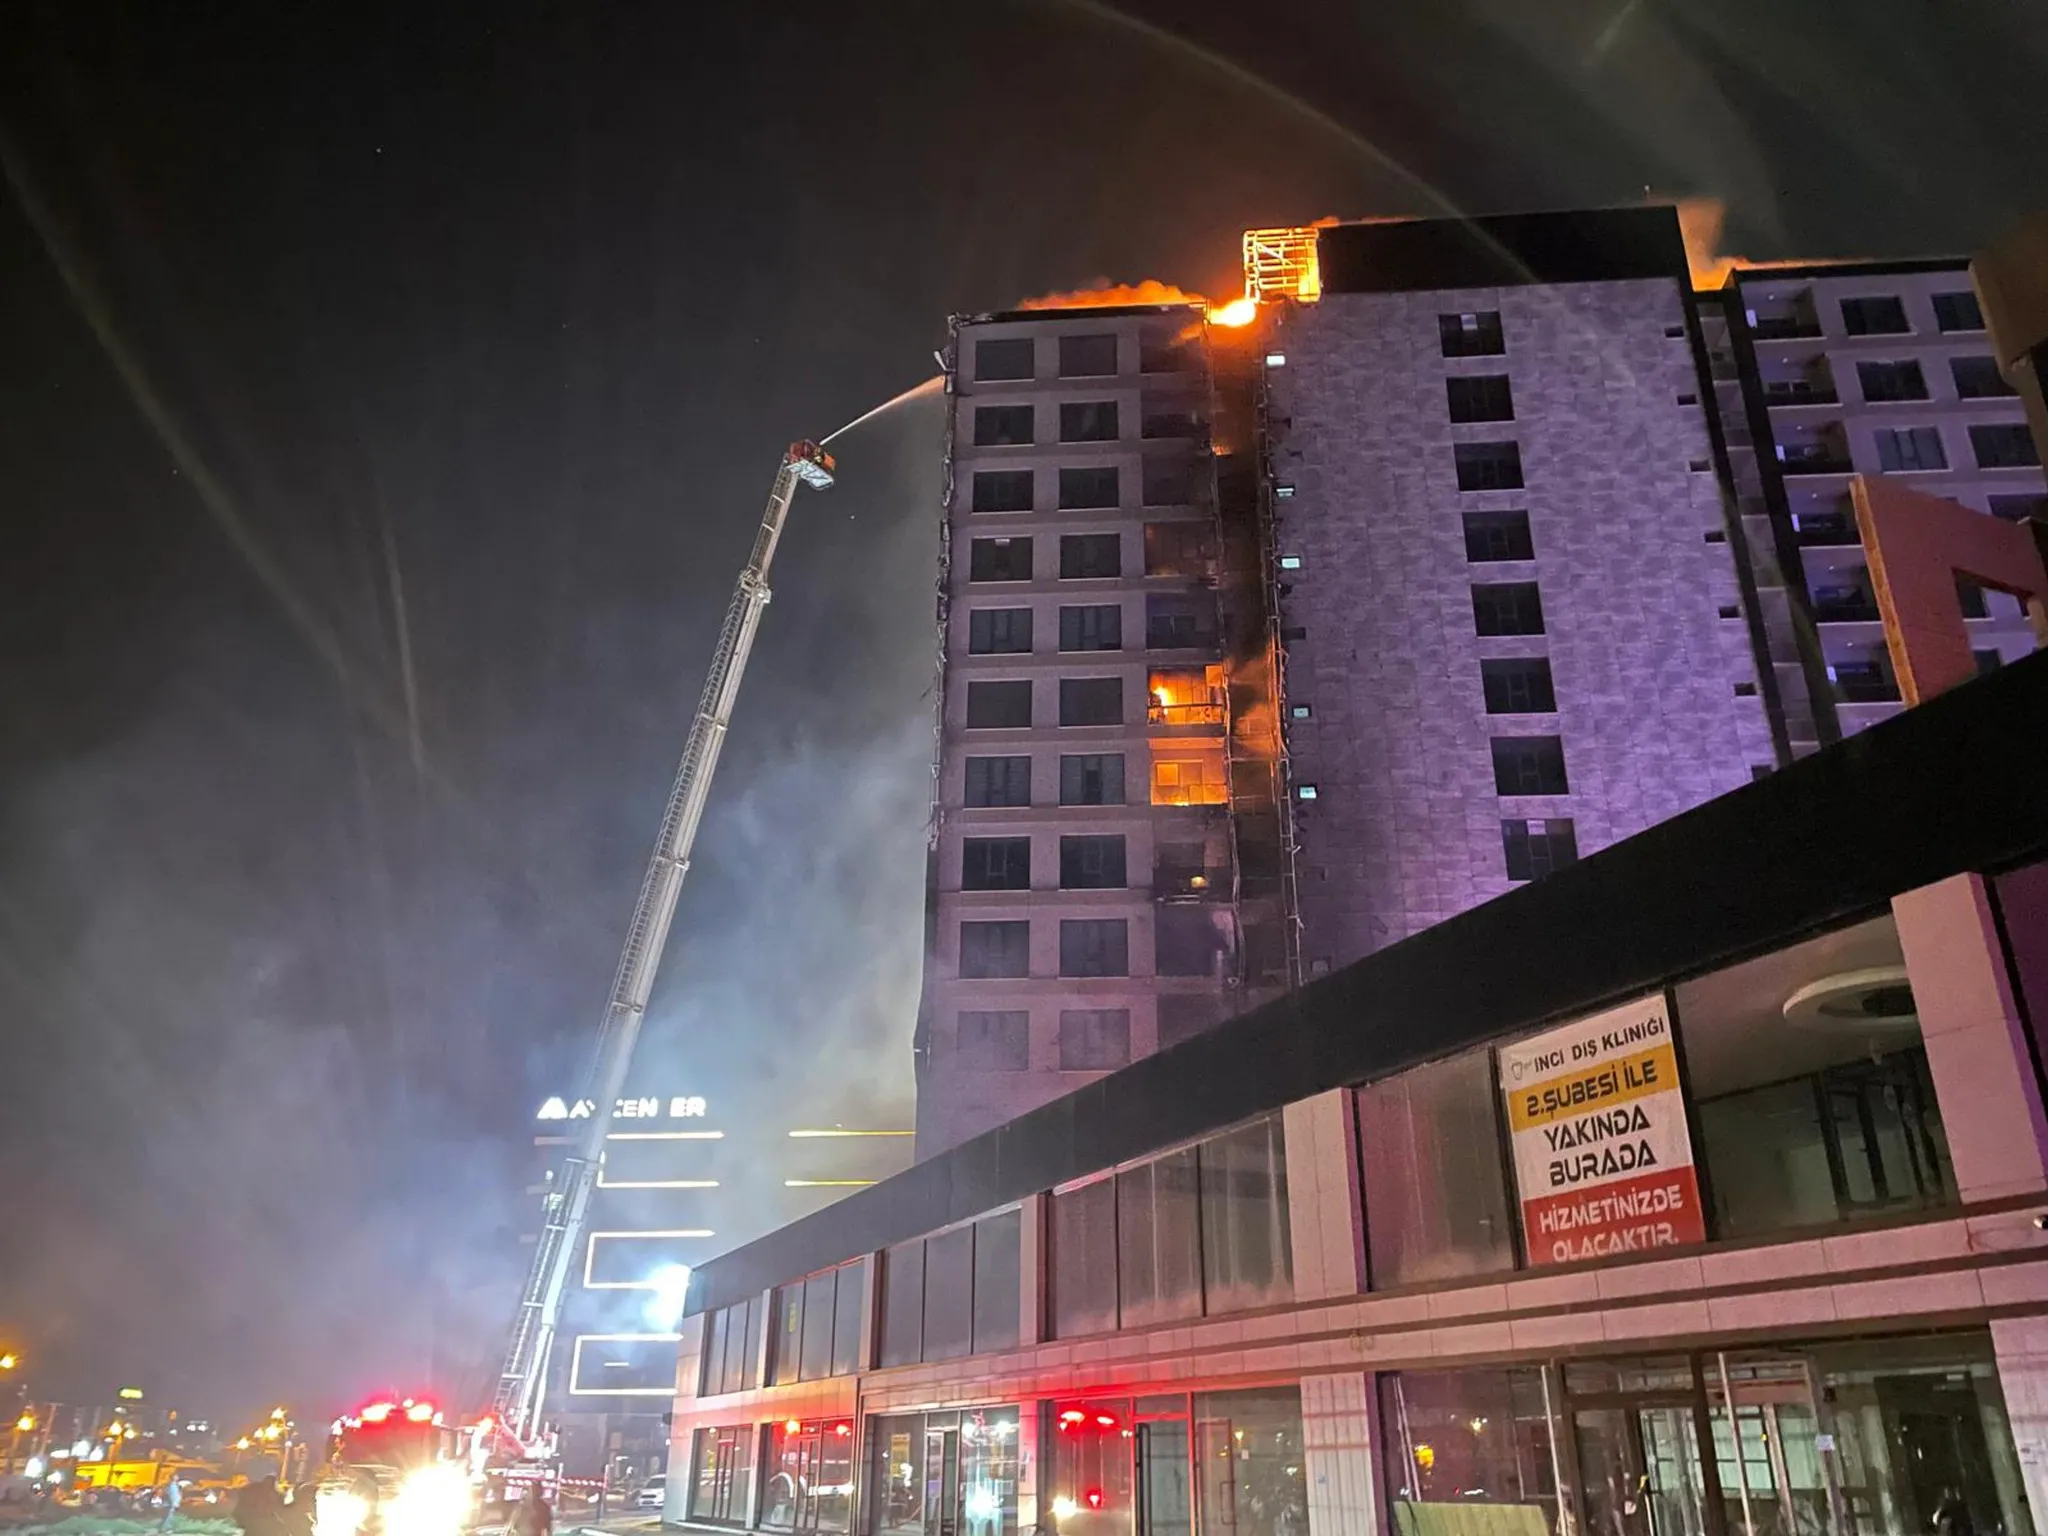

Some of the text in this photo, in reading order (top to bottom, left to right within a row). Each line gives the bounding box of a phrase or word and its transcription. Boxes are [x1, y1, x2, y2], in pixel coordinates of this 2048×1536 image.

[1622, 1059, 1658, 1090] İLE
[1544, 1104, 1651, 1152] YAKINDA
[1550, 1138, 1657, 1187] BURADA
[1539, 1184, 1684, 1234] HİZMETİNİZDE
